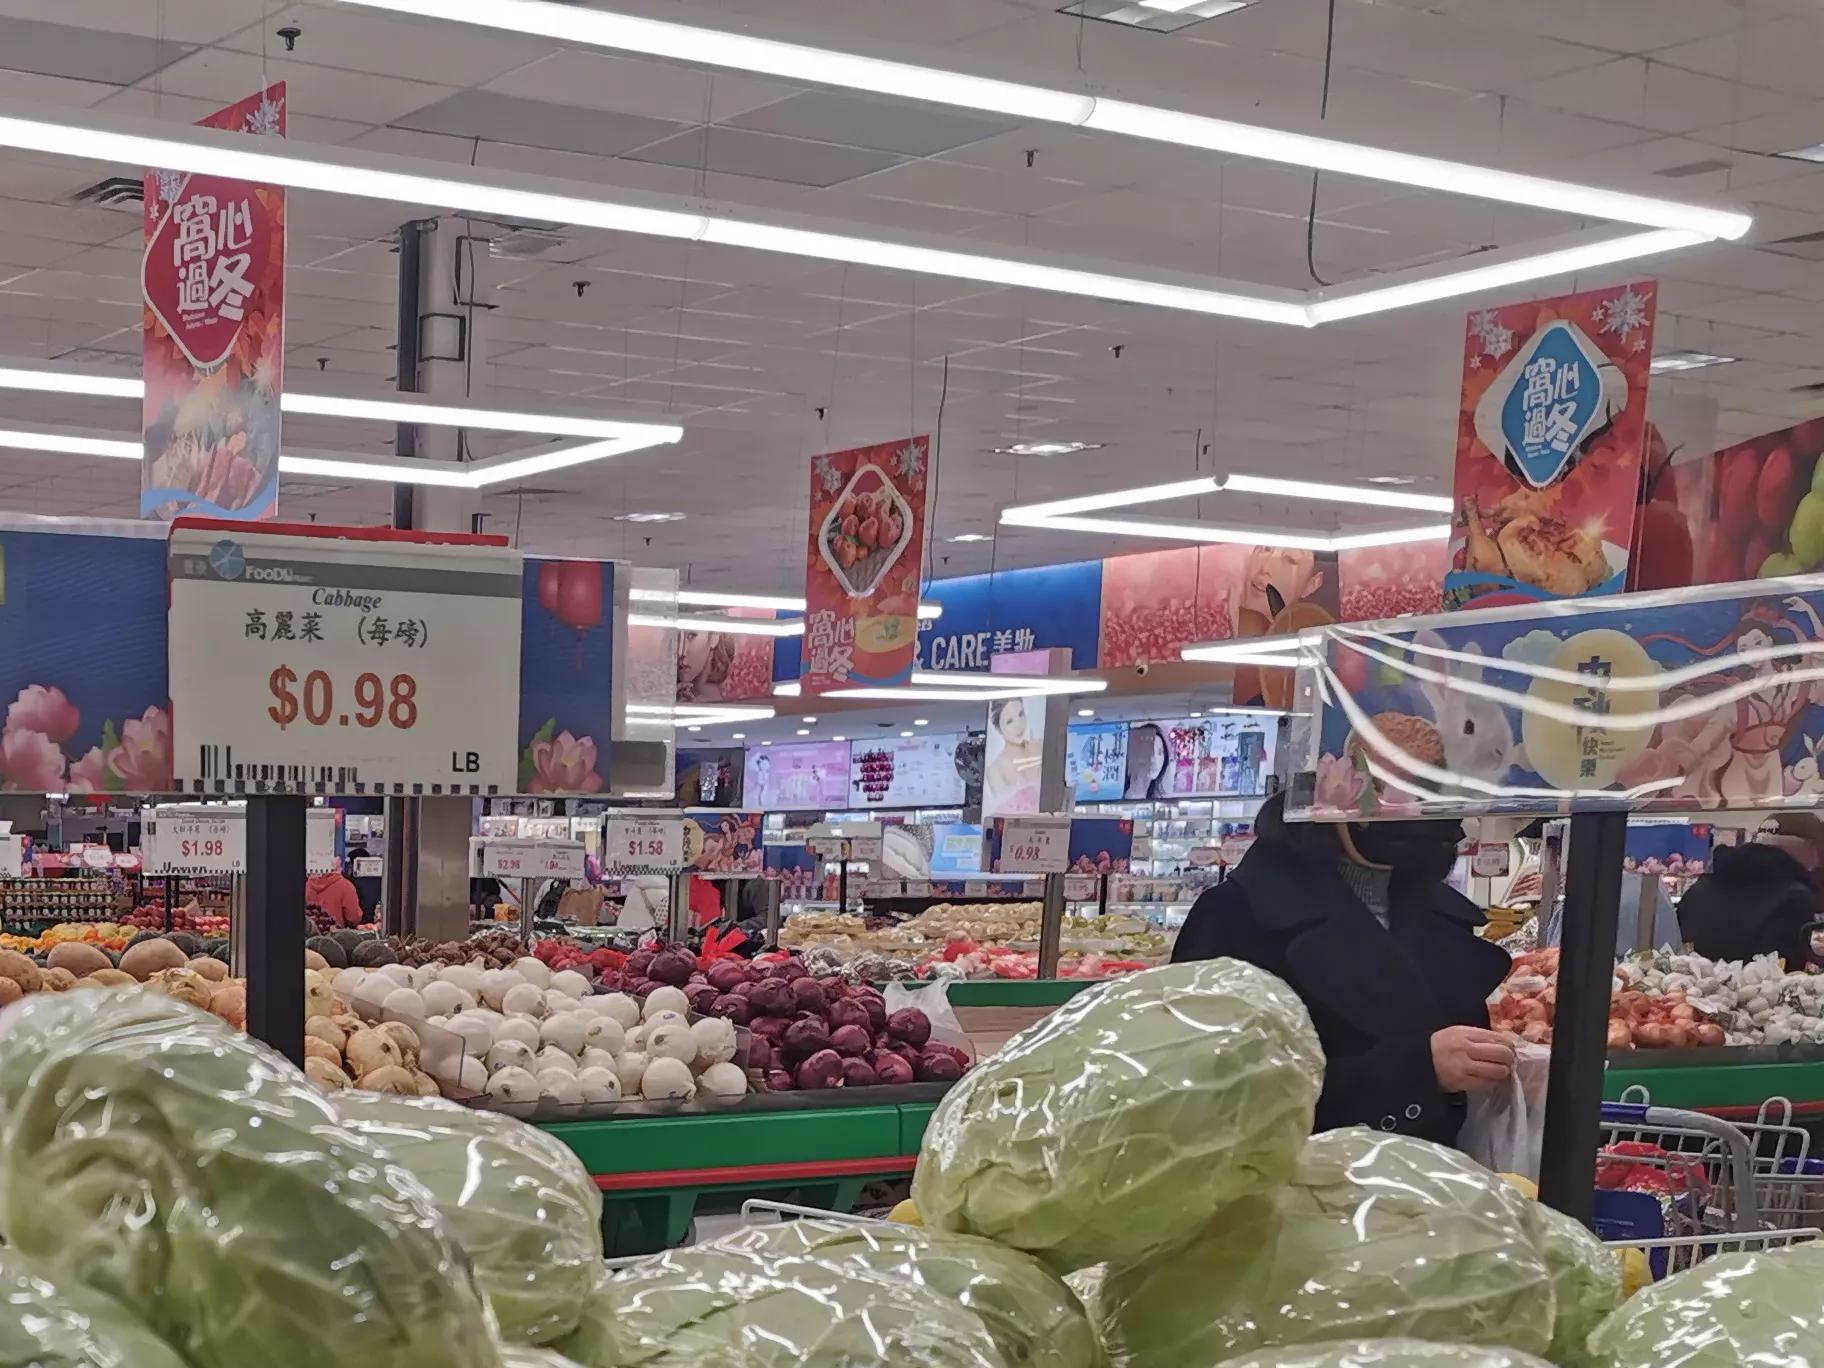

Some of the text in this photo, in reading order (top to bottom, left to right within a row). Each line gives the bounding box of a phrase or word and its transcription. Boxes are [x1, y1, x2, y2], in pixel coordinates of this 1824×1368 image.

[173, 194, 254, 267] 窩心
[176, 252, 256, 322] 過冬
[311, 587, 383, 614] Cabbage
[244, 608, 325, 643] 高麗菜
[930, 631, 990, 671] CARE
[267, 664, 418, 731] $0.98
[451, 750, 481, 774] LB
[181, 839, 224, 858] $1.98
[628, 839, 664, 857] $1.58
